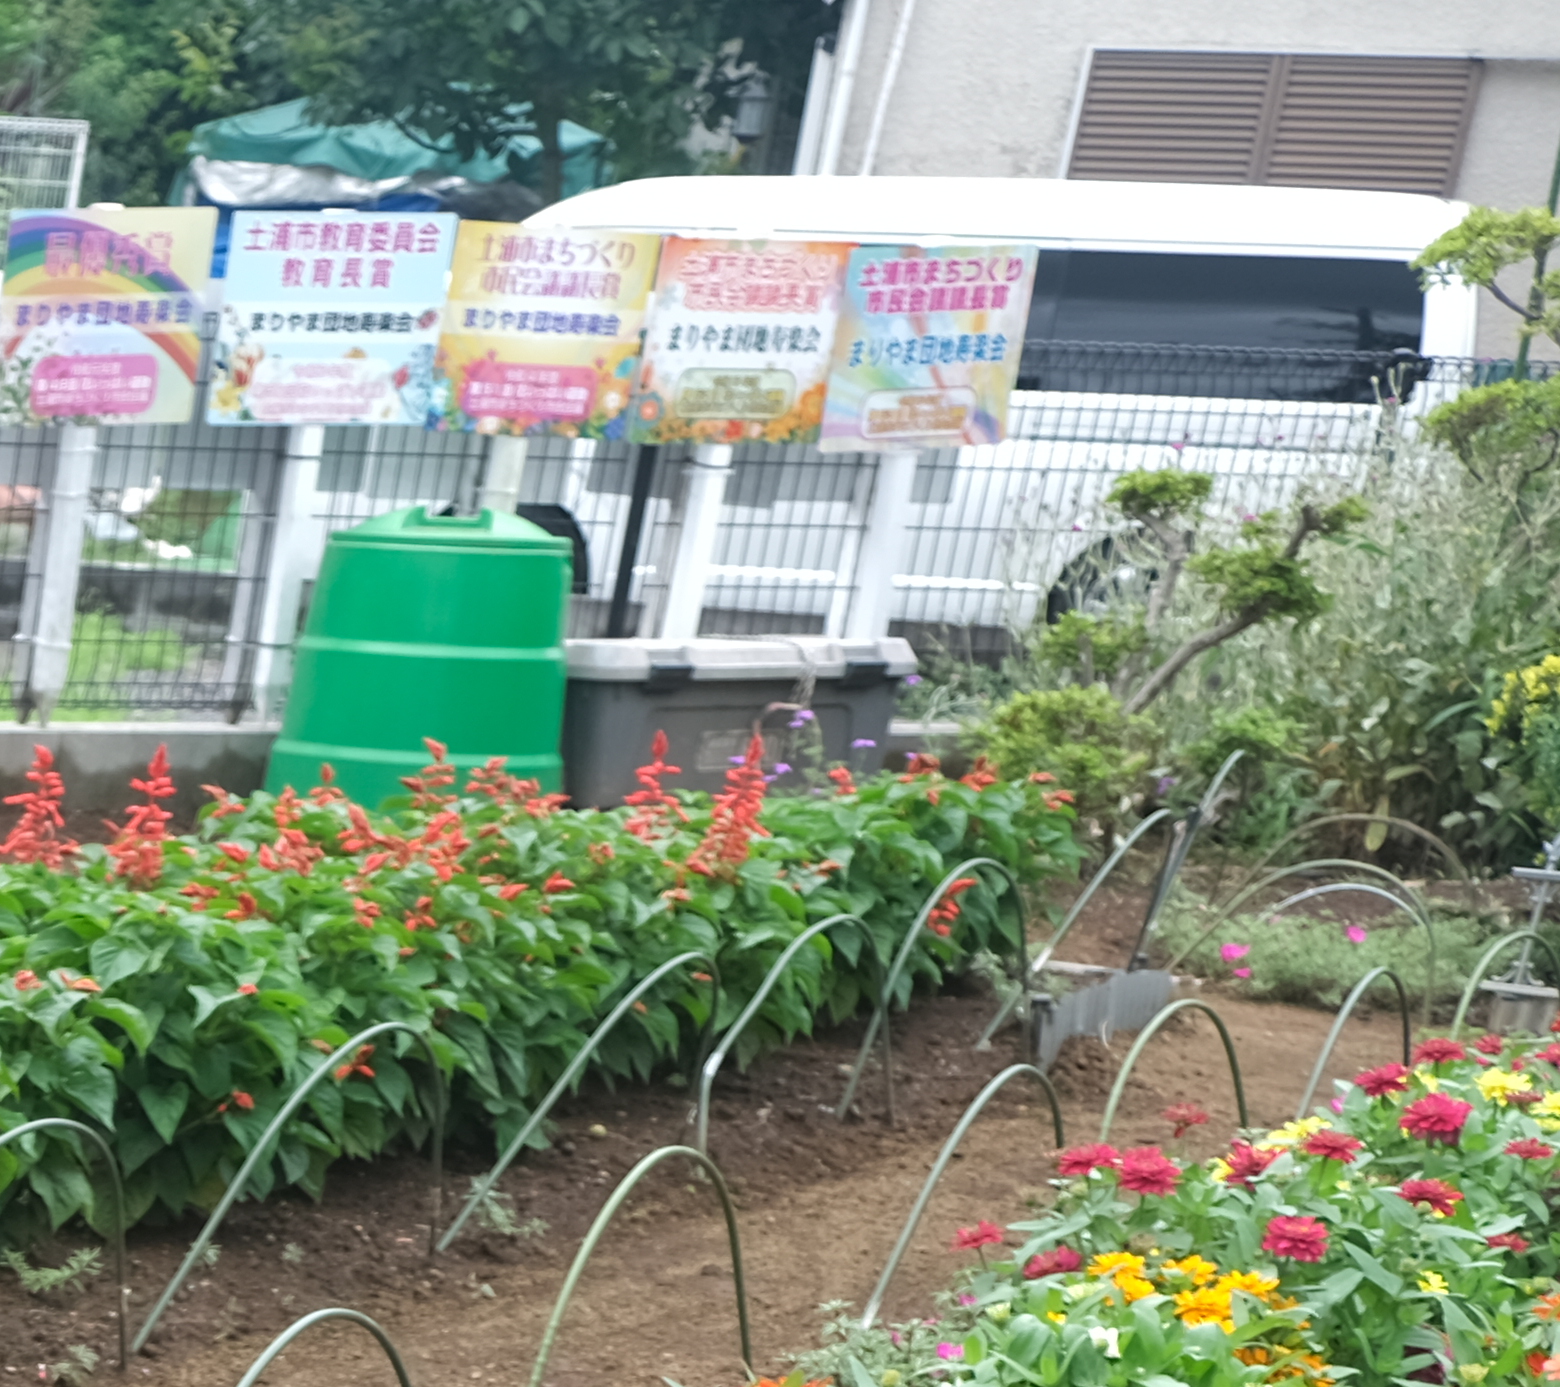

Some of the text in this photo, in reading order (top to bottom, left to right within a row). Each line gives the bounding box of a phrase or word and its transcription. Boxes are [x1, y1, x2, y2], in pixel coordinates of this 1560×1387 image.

[243, 220, 441, 253] 土浦市教育委員会
[479, 233, 636, 268] 土浦市まちづくり
[45, 230, 174, 277] 最優秀賞
[281, 257, 395, 288] 教育長賞
[860, 256, 1024, 287] 土浦市まちづくり
[17, 298, 192, 327] まりやま団地寿楽会
[250, 311, 414, 333] まりやま団地寿楽会
[464, 308, 621, 336] まりやま団地寿楽会
[667, 324, 822, 353] まりやま団地寿楽会
[849, 333, 1007, 368] まりやま団地寿楽会
